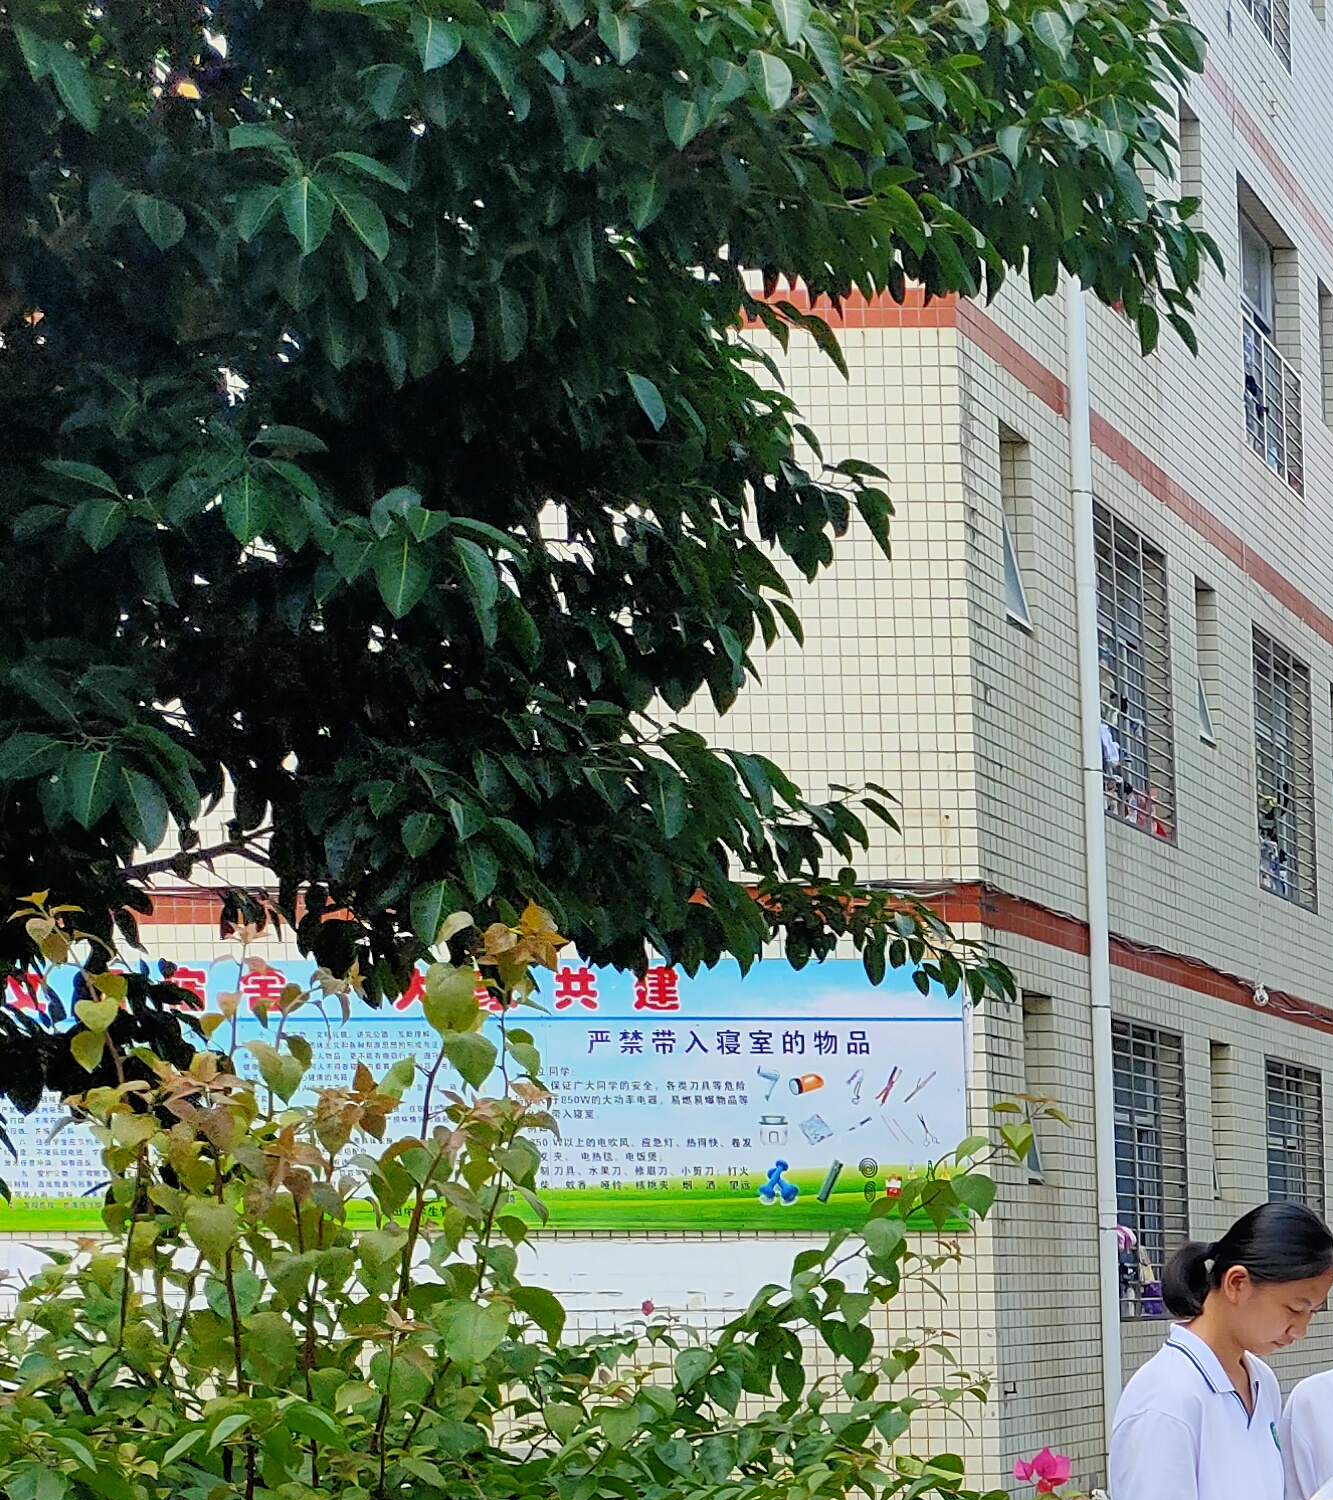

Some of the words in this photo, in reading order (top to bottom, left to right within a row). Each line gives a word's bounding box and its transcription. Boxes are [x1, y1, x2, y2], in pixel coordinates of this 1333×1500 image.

[587, 1030, 870, 1056] 严禁带入寝室的物品
[530, 1081, 746, 1092] 保证广大同学的安全，各类刀具等危险
